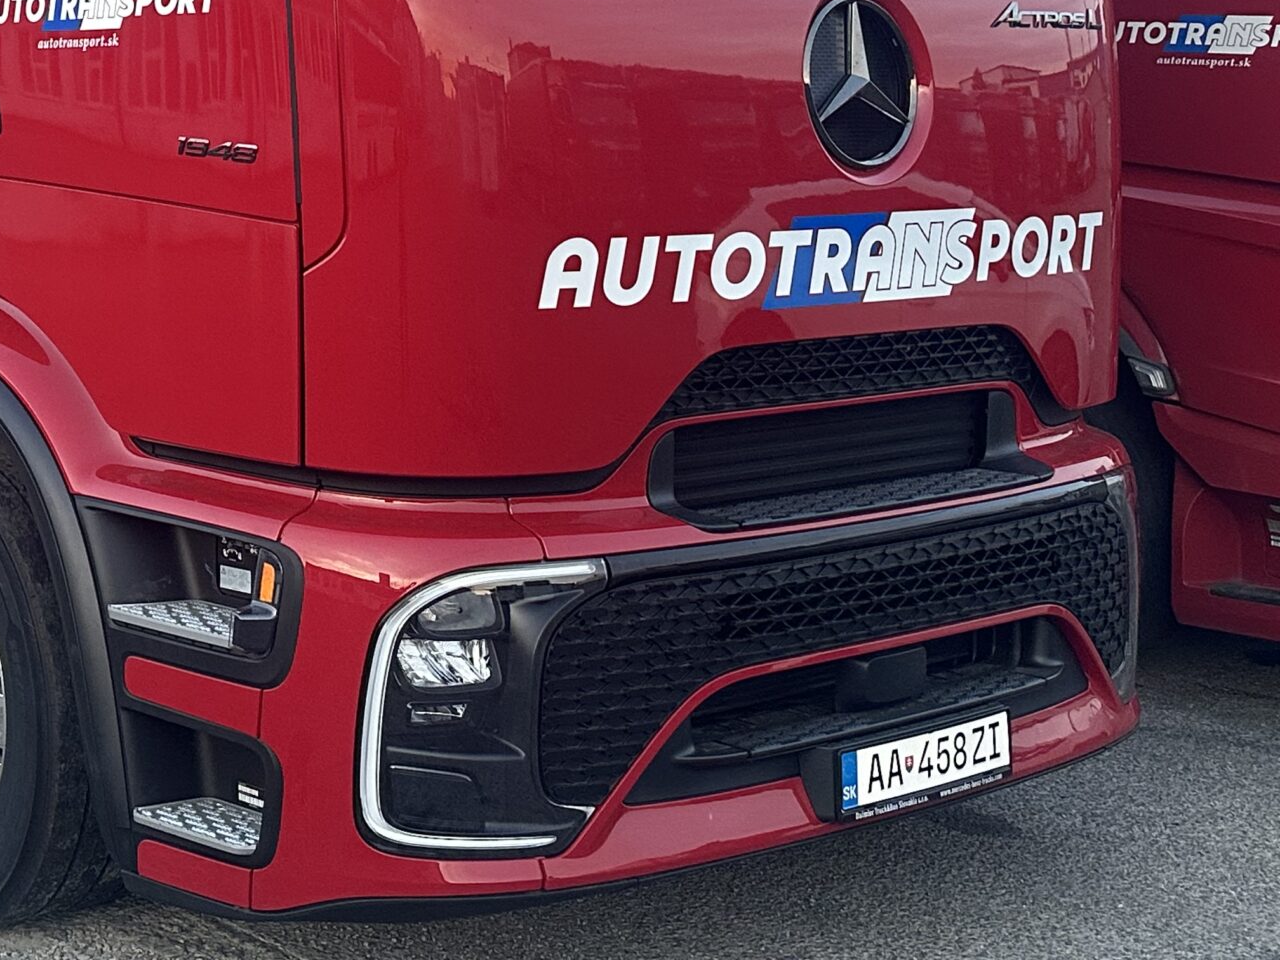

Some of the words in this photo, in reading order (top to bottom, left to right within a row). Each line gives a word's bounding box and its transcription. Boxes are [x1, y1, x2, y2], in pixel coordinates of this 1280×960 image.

[37, 33, 120, 51] autotransport.sk
[1156, 56, 1252, 69] autotransport.sk
[176, 135, 259, 164] 1948
[538, 211, 1104, 310] AUTOTRANSPORT
[867, 748, 904, 794] AA
[842, 785, 857, 800] SK
